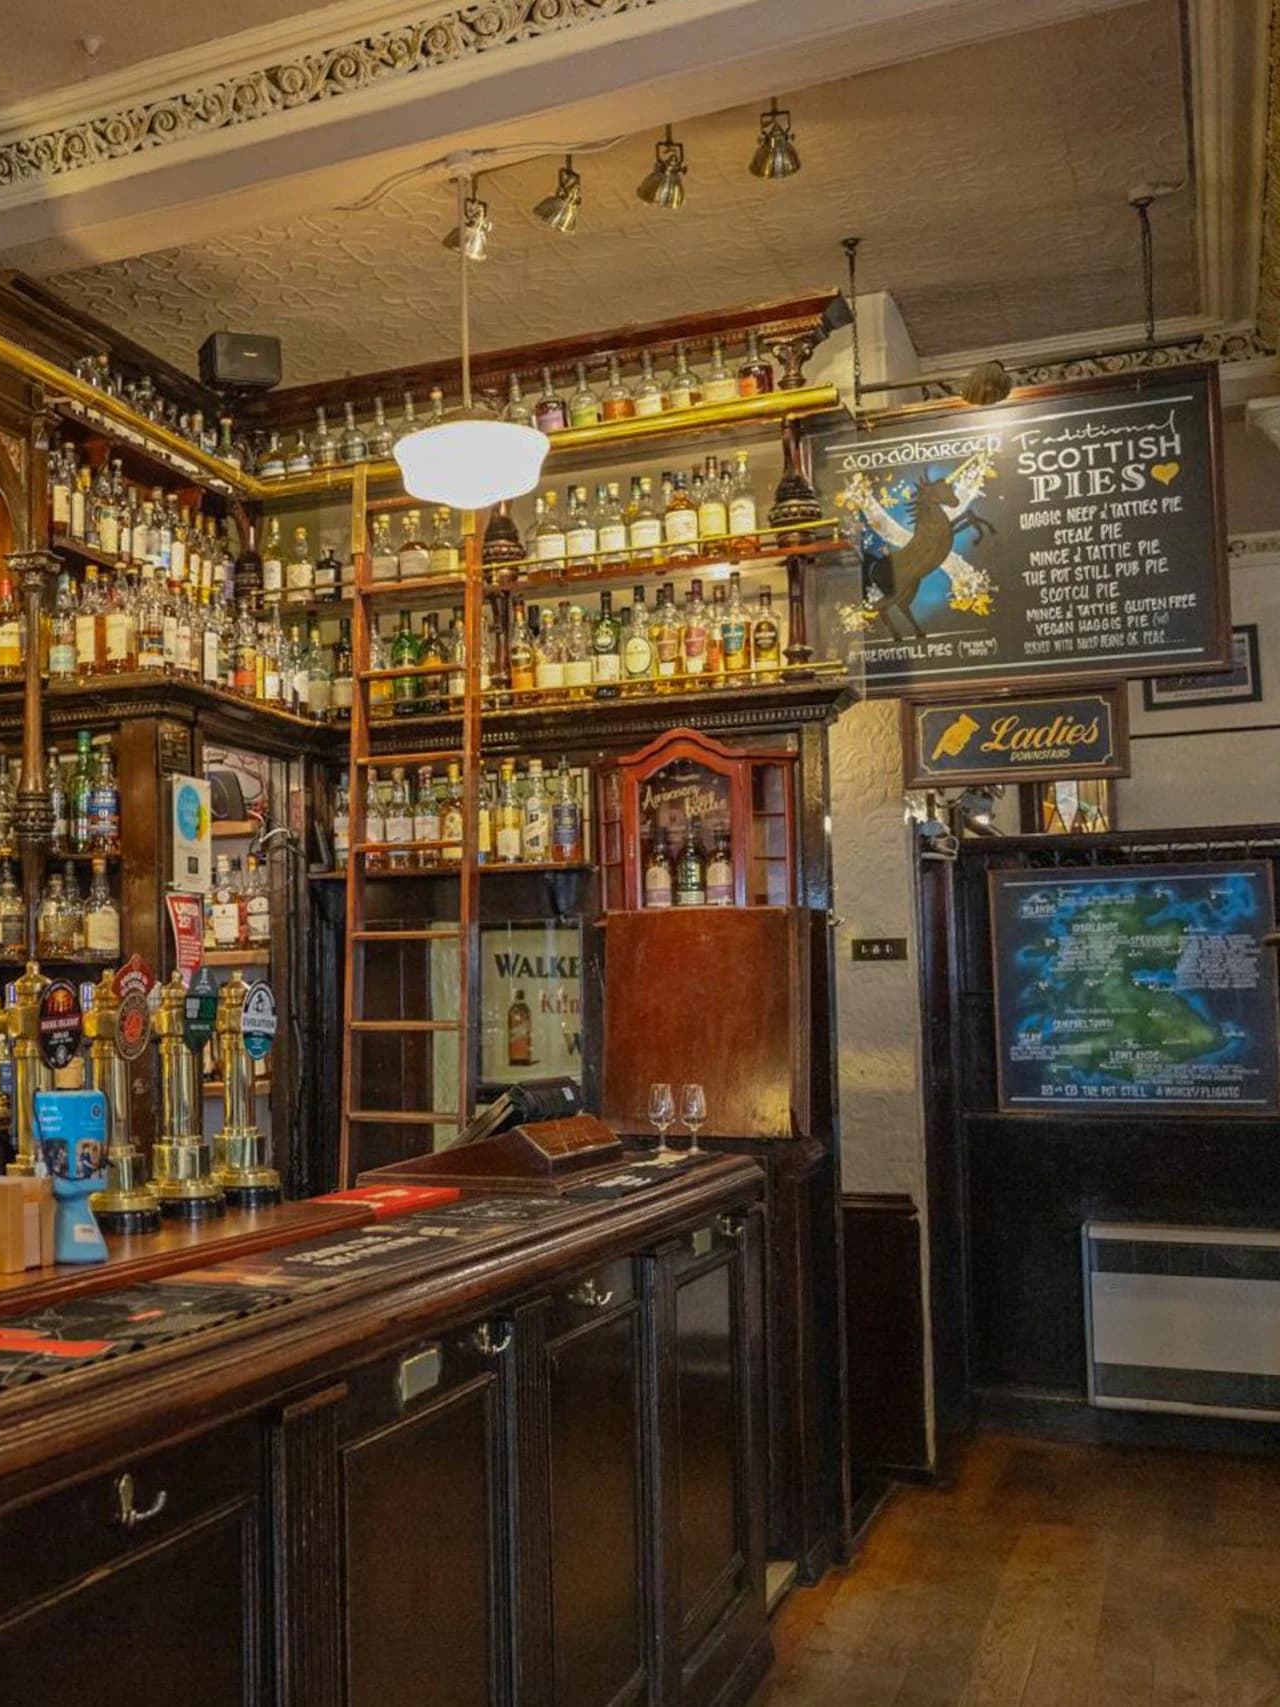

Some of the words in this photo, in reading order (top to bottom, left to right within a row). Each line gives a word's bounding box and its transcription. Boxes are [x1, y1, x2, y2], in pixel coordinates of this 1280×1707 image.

[1009, 409, 1176, 450] Traditional
[1017, 433, 1181, 475] SCOTTISH
[1028, 462, 1146, 504] PIES
[1020, 509, 1062, 530] HAGGIS
[1066, 504, 1098, 523] NEEP
[1109, 499, 1158, 518] TATTIES
[1161, 496, 1183, 514] PIE
[1054, 526, 1094, 546] STEAK
[1100, 522, 1123, 541] PIE
[1029, 548, 1070, 567] MINCE
[1085, 542, 1132, 561] TATTIE
[1138, 539, 1161, 556] PIE
[1022, 570, 1047, 586] THE
[1050, 567, 1072, 584] POT
[1074, 563, 1111, 581] STILL
[1115, 560, 1140, 578] PUB
[1145, 557, 1169, 574] PIE
[1040, 585, 1089, 604] SCOTCH
[1096, 581, 1120, 600] PIE
[1026, 606, 1064, 622] MINCE
[1077, 601, 1118, 617] TATTIE
[1125, 596, 1167, 614] GLUTEN
[1168, 593, 1197, 609] FREE
[1036, 621, 1074, 637] VEGAN
[1078, 617, 1122, 632] HAGGIS
[1127, 614, 1149, 628] PIE
[980, 715, 1100, 752] Ladies
[493, 953, 581, 978] WALKE
